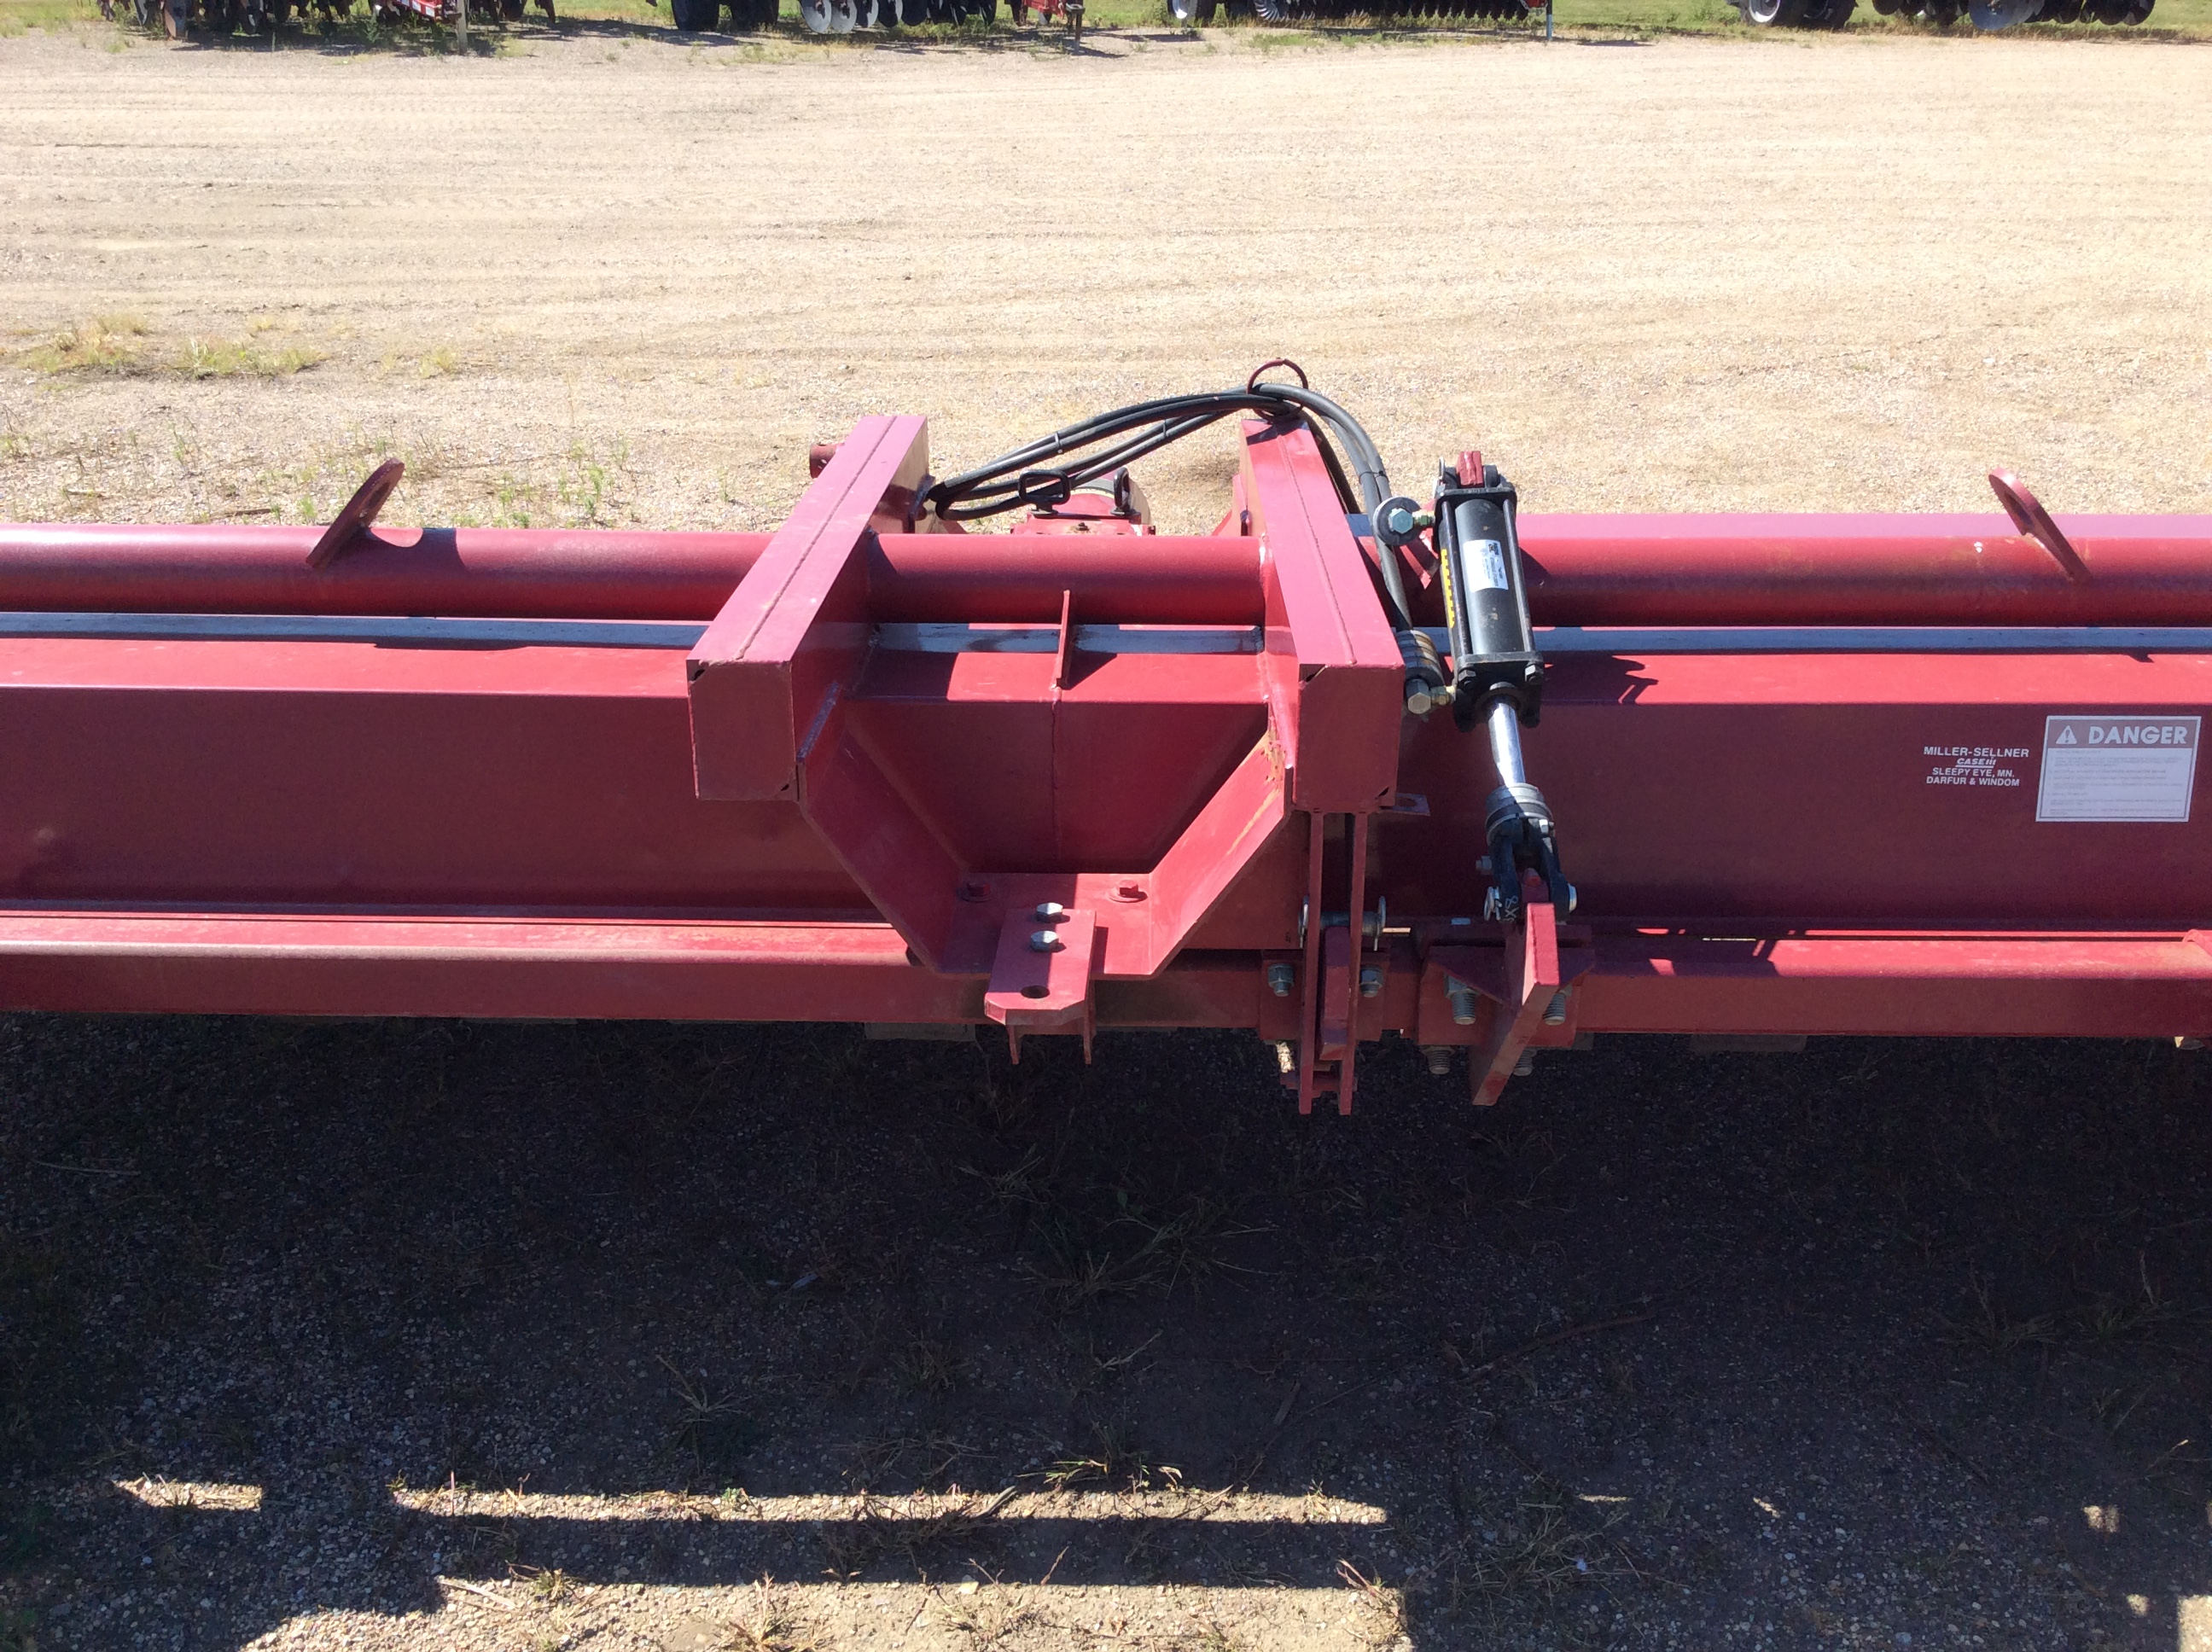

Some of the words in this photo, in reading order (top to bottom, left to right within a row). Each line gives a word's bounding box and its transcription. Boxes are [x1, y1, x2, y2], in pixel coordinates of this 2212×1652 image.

[2088, 725, 2188, 745] DANGER
[1924, 746, 2029, 758] MILLER-SELLNER
[1932, 767, 1970, 776] SLEEPY
[1972, 768, 1995, 777] EYE,
[1926, 776, 1966, 785] DARFUR
[1978, 777, 2020, 786] WINDOM
